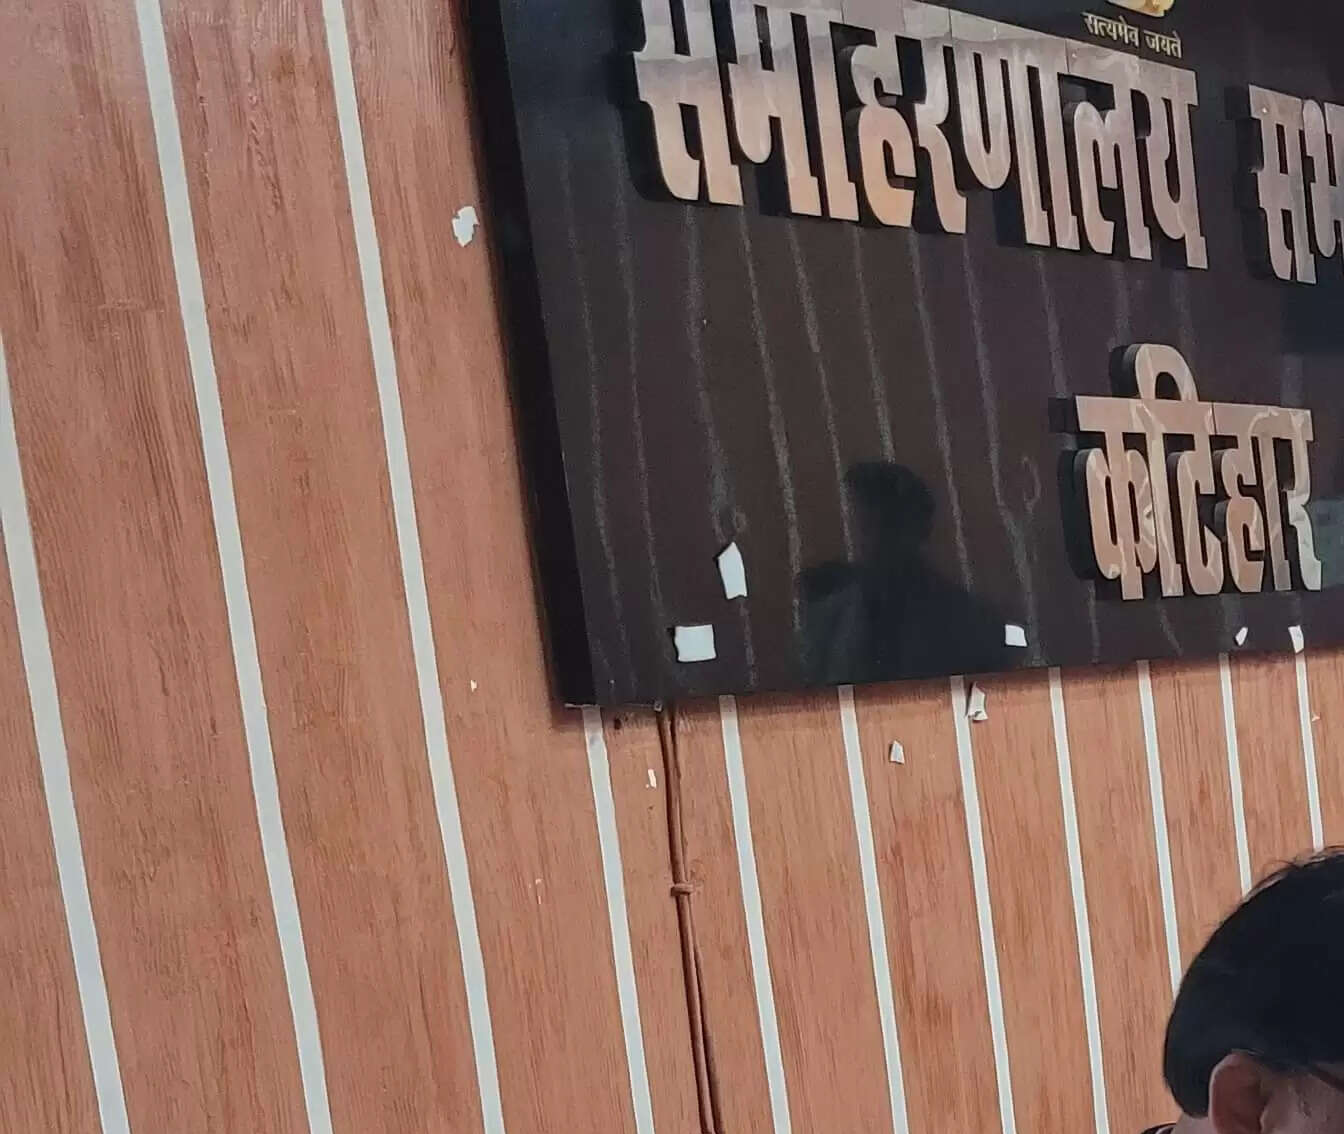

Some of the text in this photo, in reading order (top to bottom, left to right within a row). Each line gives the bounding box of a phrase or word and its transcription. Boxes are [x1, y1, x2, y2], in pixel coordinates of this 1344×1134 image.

[633, 0, 1208, 269] समाहरणालय
[1083, 13, 1183, 58] सत्यमेव जयते
[1075, 343, 1322, 600] कटिहार
